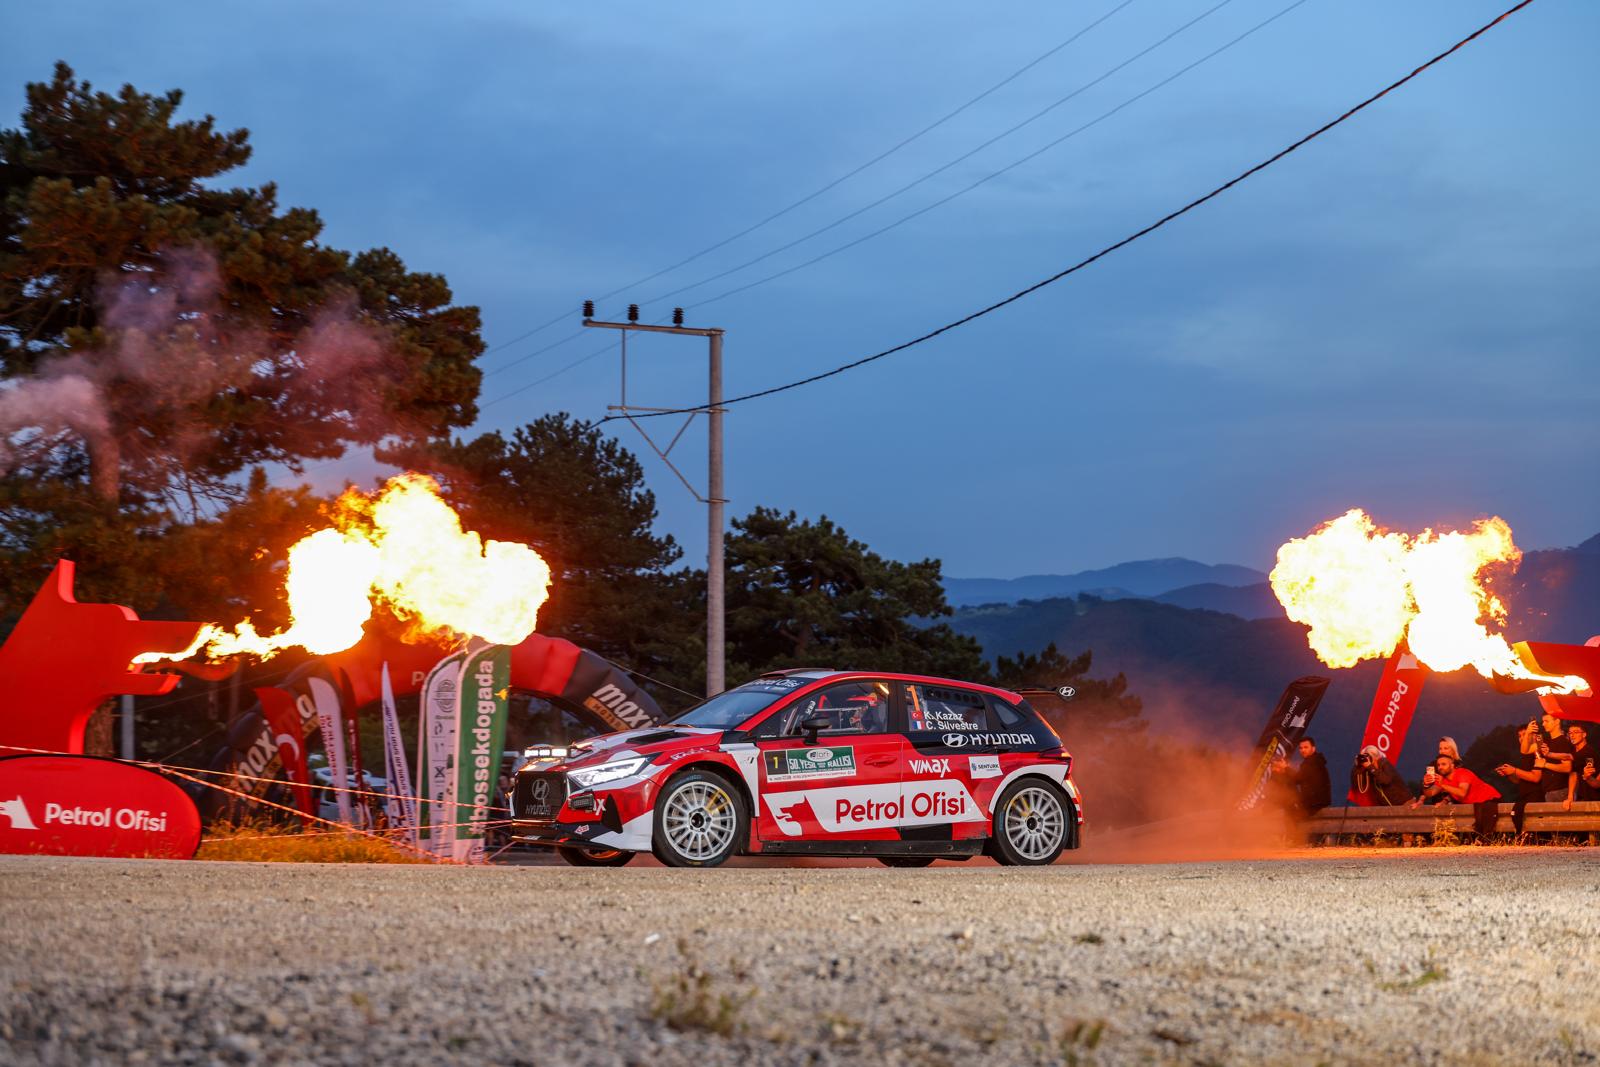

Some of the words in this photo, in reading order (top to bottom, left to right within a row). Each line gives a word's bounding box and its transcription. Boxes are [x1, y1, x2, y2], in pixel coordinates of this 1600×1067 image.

[1382, 680, 1408, 733] Petrol
[936, 711, 964, 720] Kazaz
[939, 721, 979, 730] Silvestre
[970, 734, 1037, 745] HYUNDAI
[773, 756, 779, 769] 1
[836, 795, 905, 824] Petrol
[912, 791, 966, 818] Ofisi
[44, 803, 111, 827] Petrol
[115, 809, 168, 832] Ofisi
